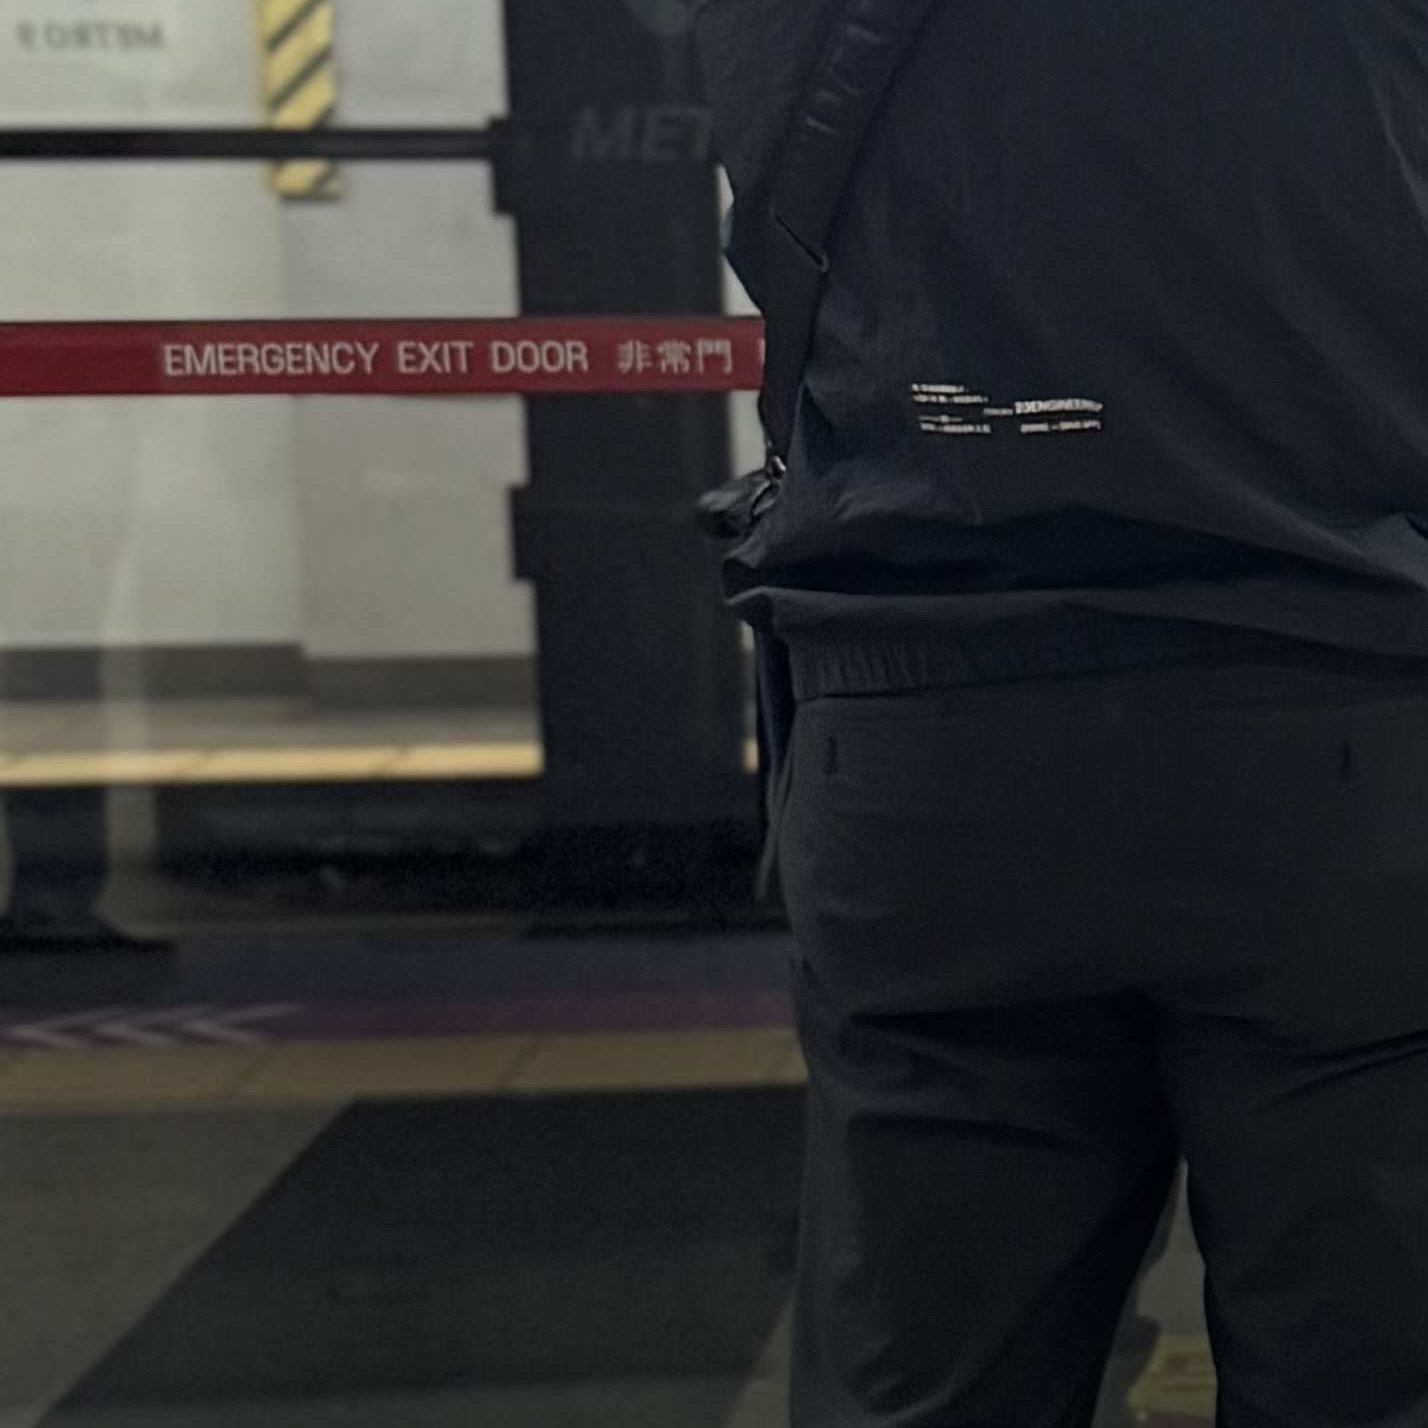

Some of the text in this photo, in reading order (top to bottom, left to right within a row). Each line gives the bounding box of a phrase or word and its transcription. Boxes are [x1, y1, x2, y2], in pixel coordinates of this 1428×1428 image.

[163, 339, 734, 376] EMERGENCY EXIT DOOR 非常門
